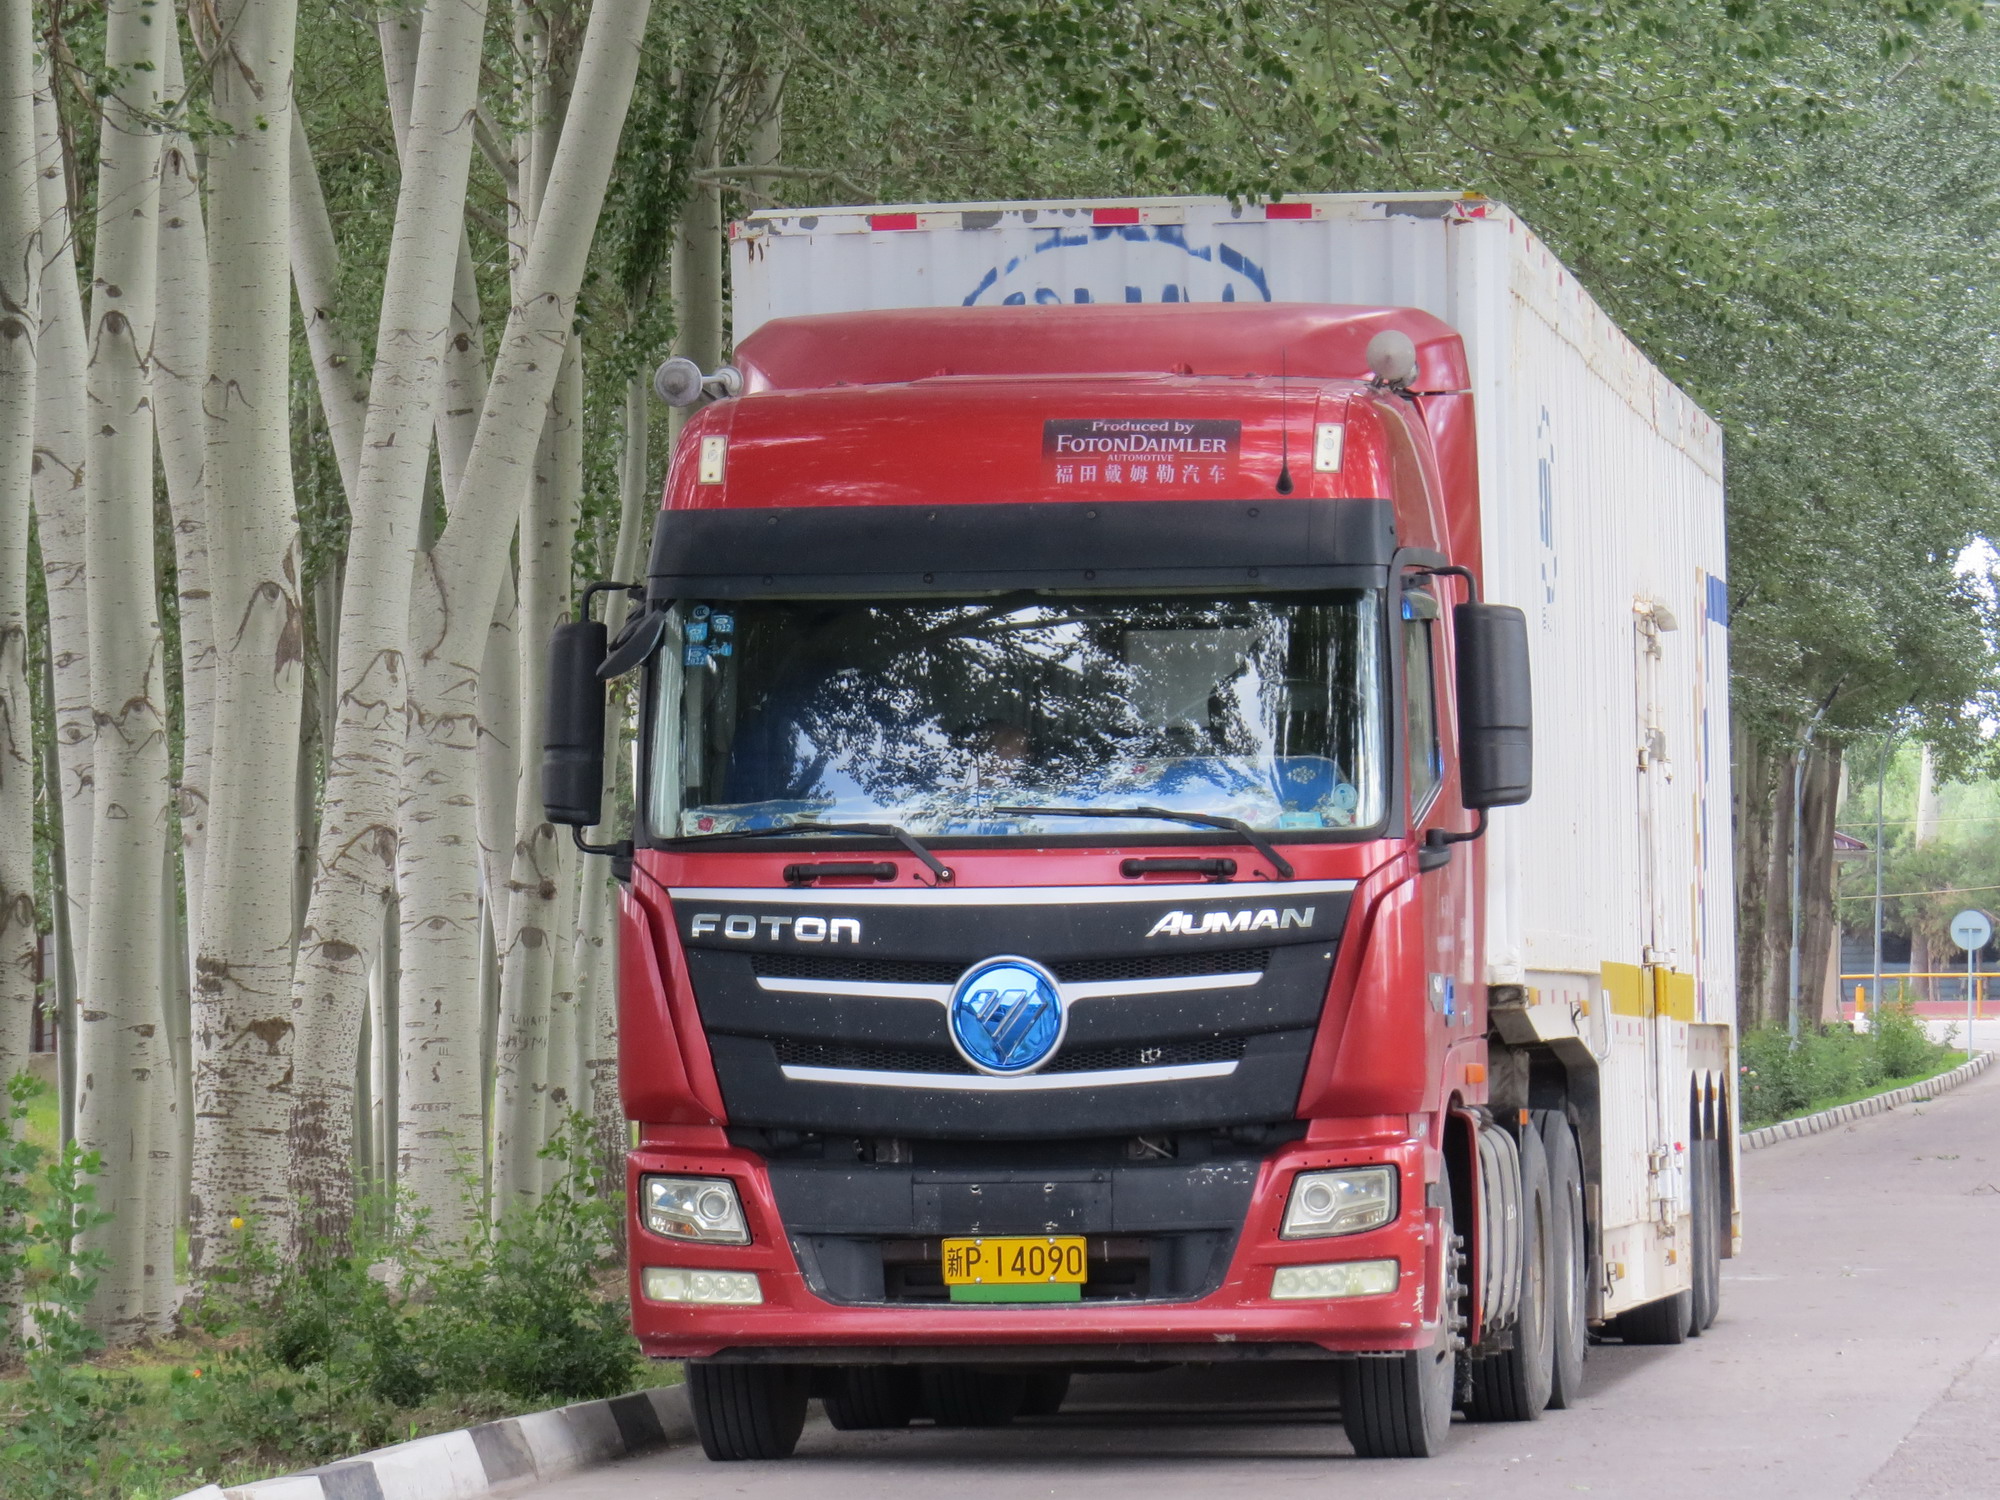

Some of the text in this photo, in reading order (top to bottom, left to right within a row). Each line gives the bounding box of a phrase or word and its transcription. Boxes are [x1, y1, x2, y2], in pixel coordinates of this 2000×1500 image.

[1092, 421, 1195, 434] Produced by
[1107, 454, 1174, 462] AUTOMOTIVE
[1056, 464, 1226, 484] 福田戴姆勒汽车
[691, 913, 861, 943] FOTON
[1145, 907, 1316, 937] AUMAN
